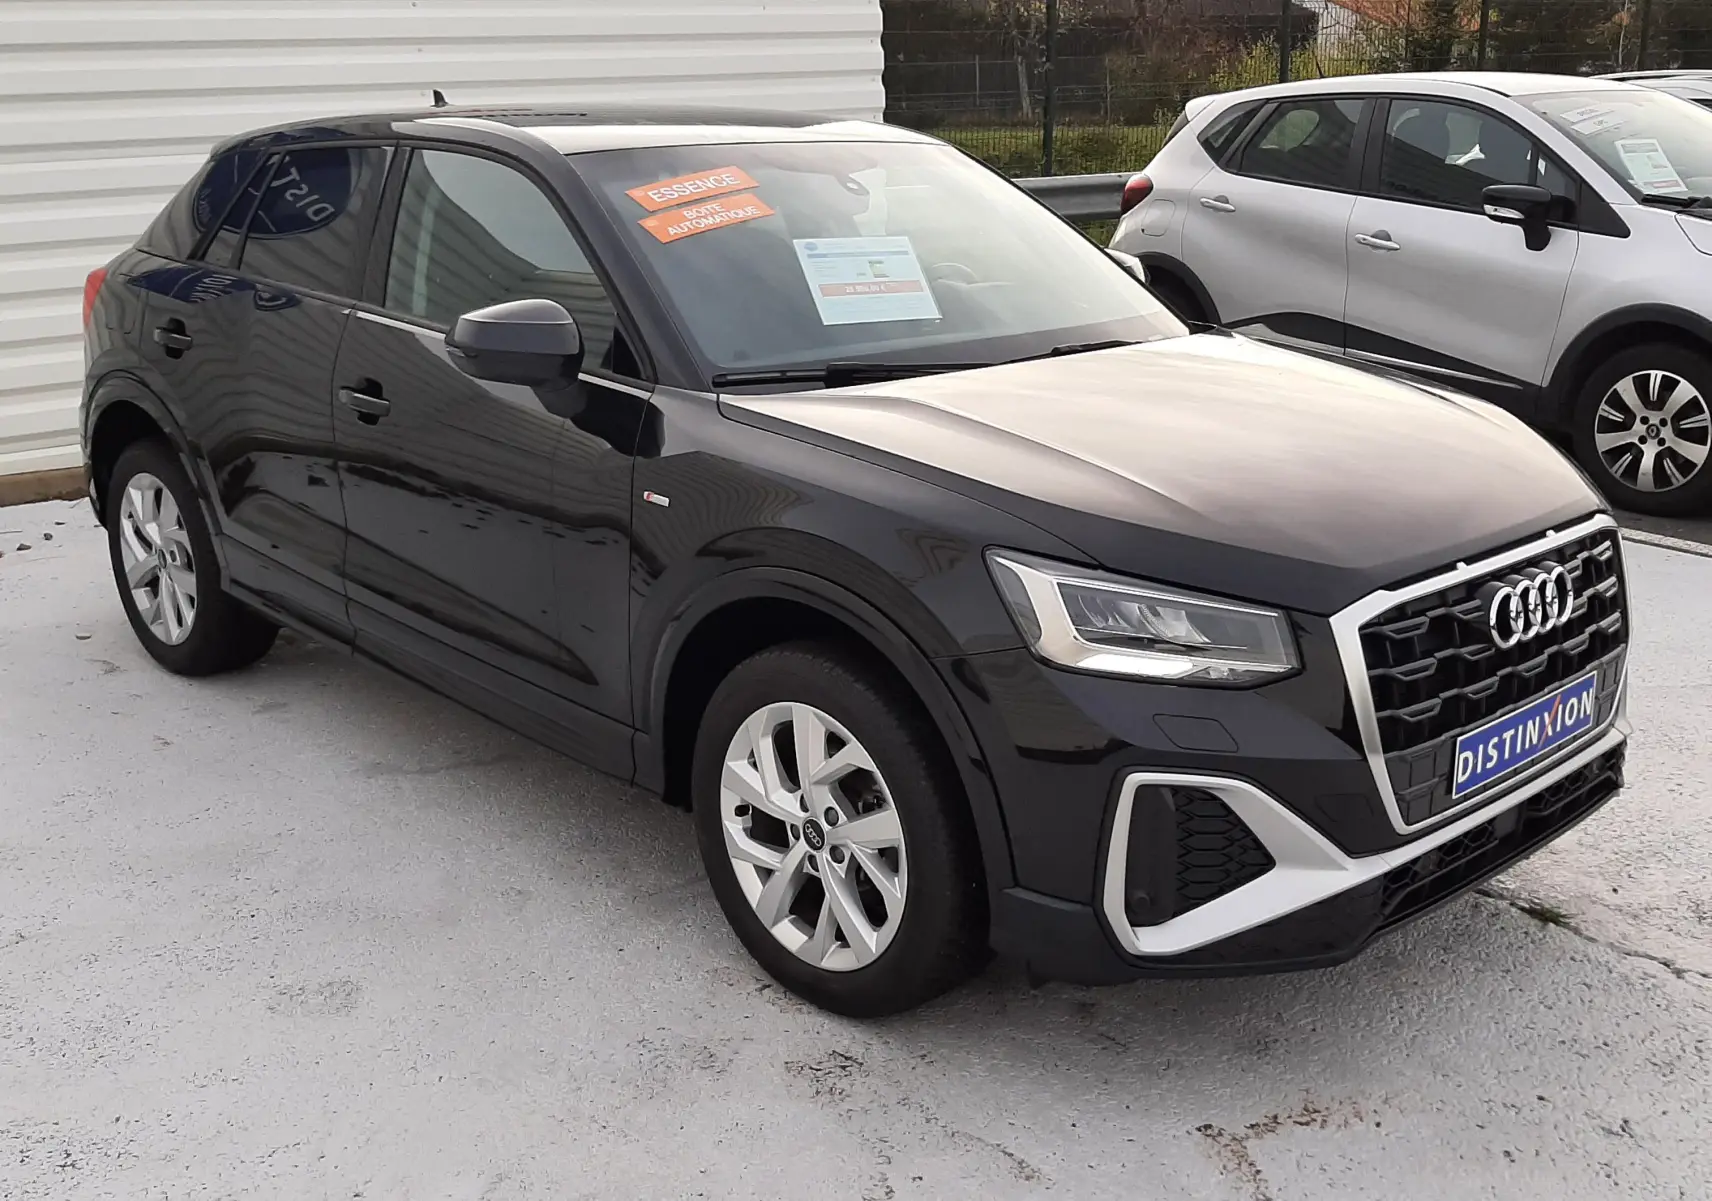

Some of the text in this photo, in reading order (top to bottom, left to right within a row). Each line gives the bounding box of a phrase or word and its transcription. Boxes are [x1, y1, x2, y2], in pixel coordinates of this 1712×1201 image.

[647, 173, 741, 202] ESSENCE
[667, 206, 760, 236] AUTOMATIQUE
[683, 203, 727, 220] BOITE
[1457, 688, 1594, 784] DISTINXION
